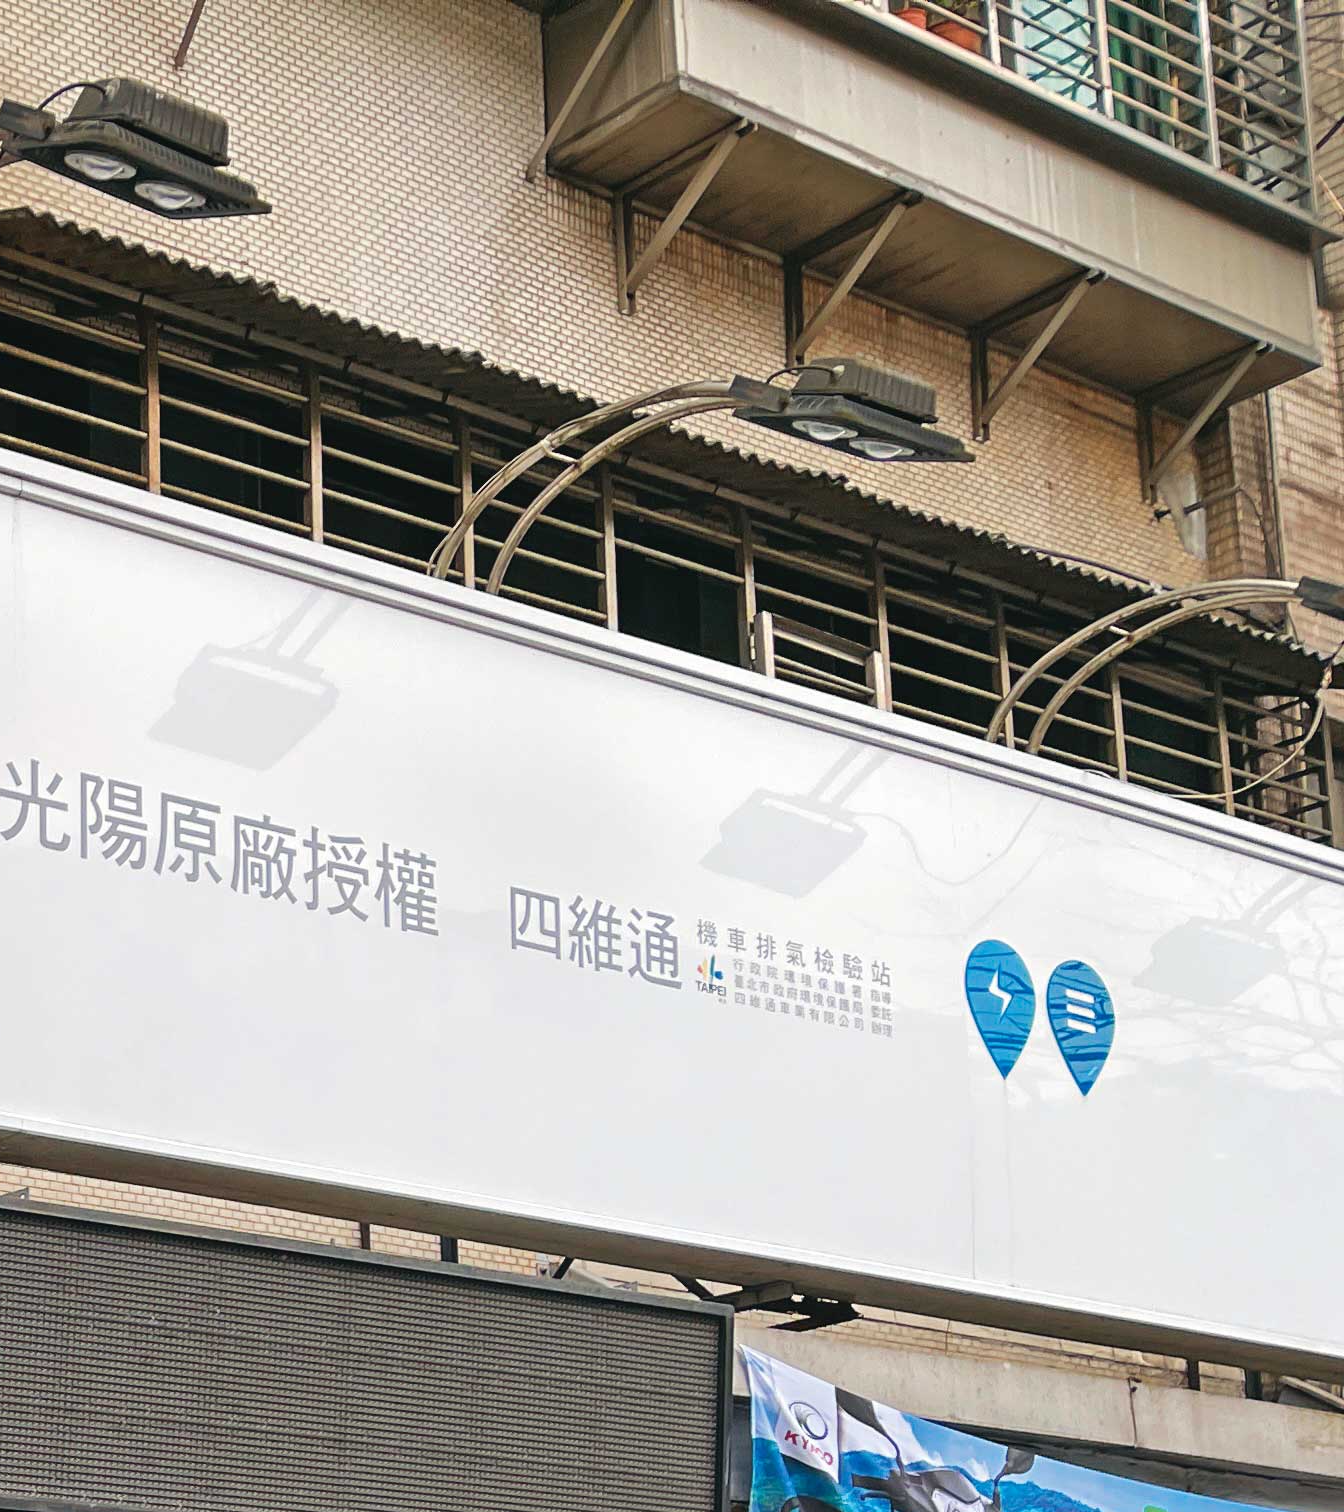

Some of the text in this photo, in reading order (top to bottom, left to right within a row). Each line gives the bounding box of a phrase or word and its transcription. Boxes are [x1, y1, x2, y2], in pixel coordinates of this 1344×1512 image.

[509, 885, 683, 991] 四維通
[696, 918, 892, 988] 機車排氣檢驗站
[695, 980, 727, 997] TAIPEI
